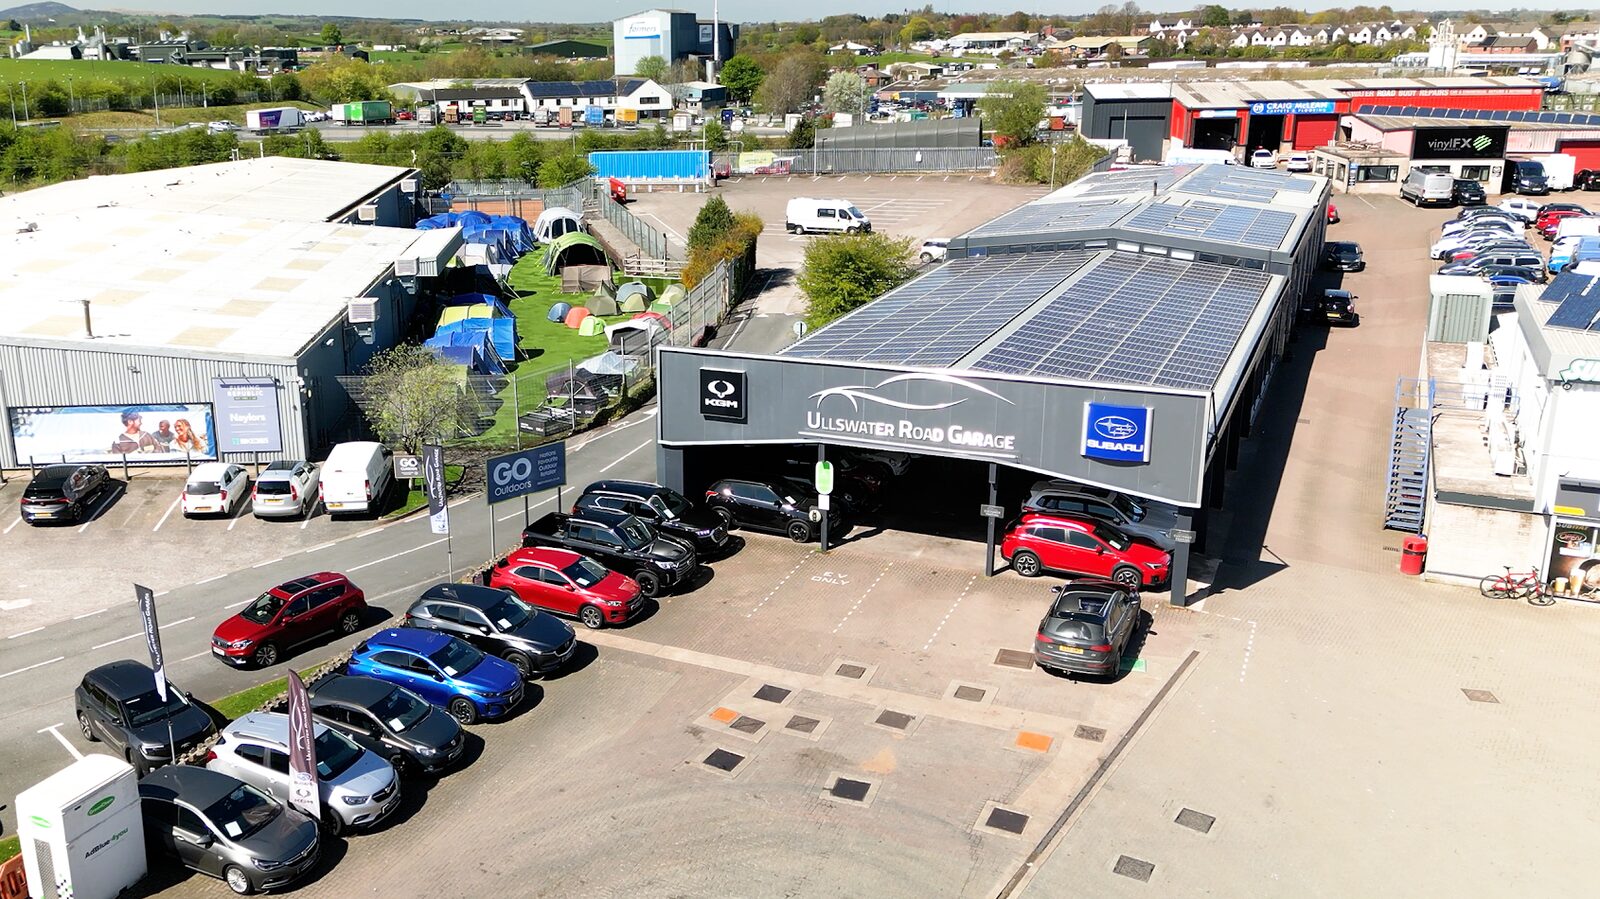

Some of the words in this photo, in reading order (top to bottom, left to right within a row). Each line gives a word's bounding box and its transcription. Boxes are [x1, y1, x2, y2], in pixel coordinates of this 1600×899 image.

[1266, 102, 1292, 110] CRAIG
[1428, 138, 1472, 151] vinylFX
[704, 398, 738, 409] KGM
[229, 412, 266, 423] Naylors
[1087, 439, 1144, 453] SUBARU
[400, 458, 418, 467] GO
[493, 457, 532, 486] GO
[494, 480, 532, 496] Outdoors
[811, 575, 850, 585] ONLY
